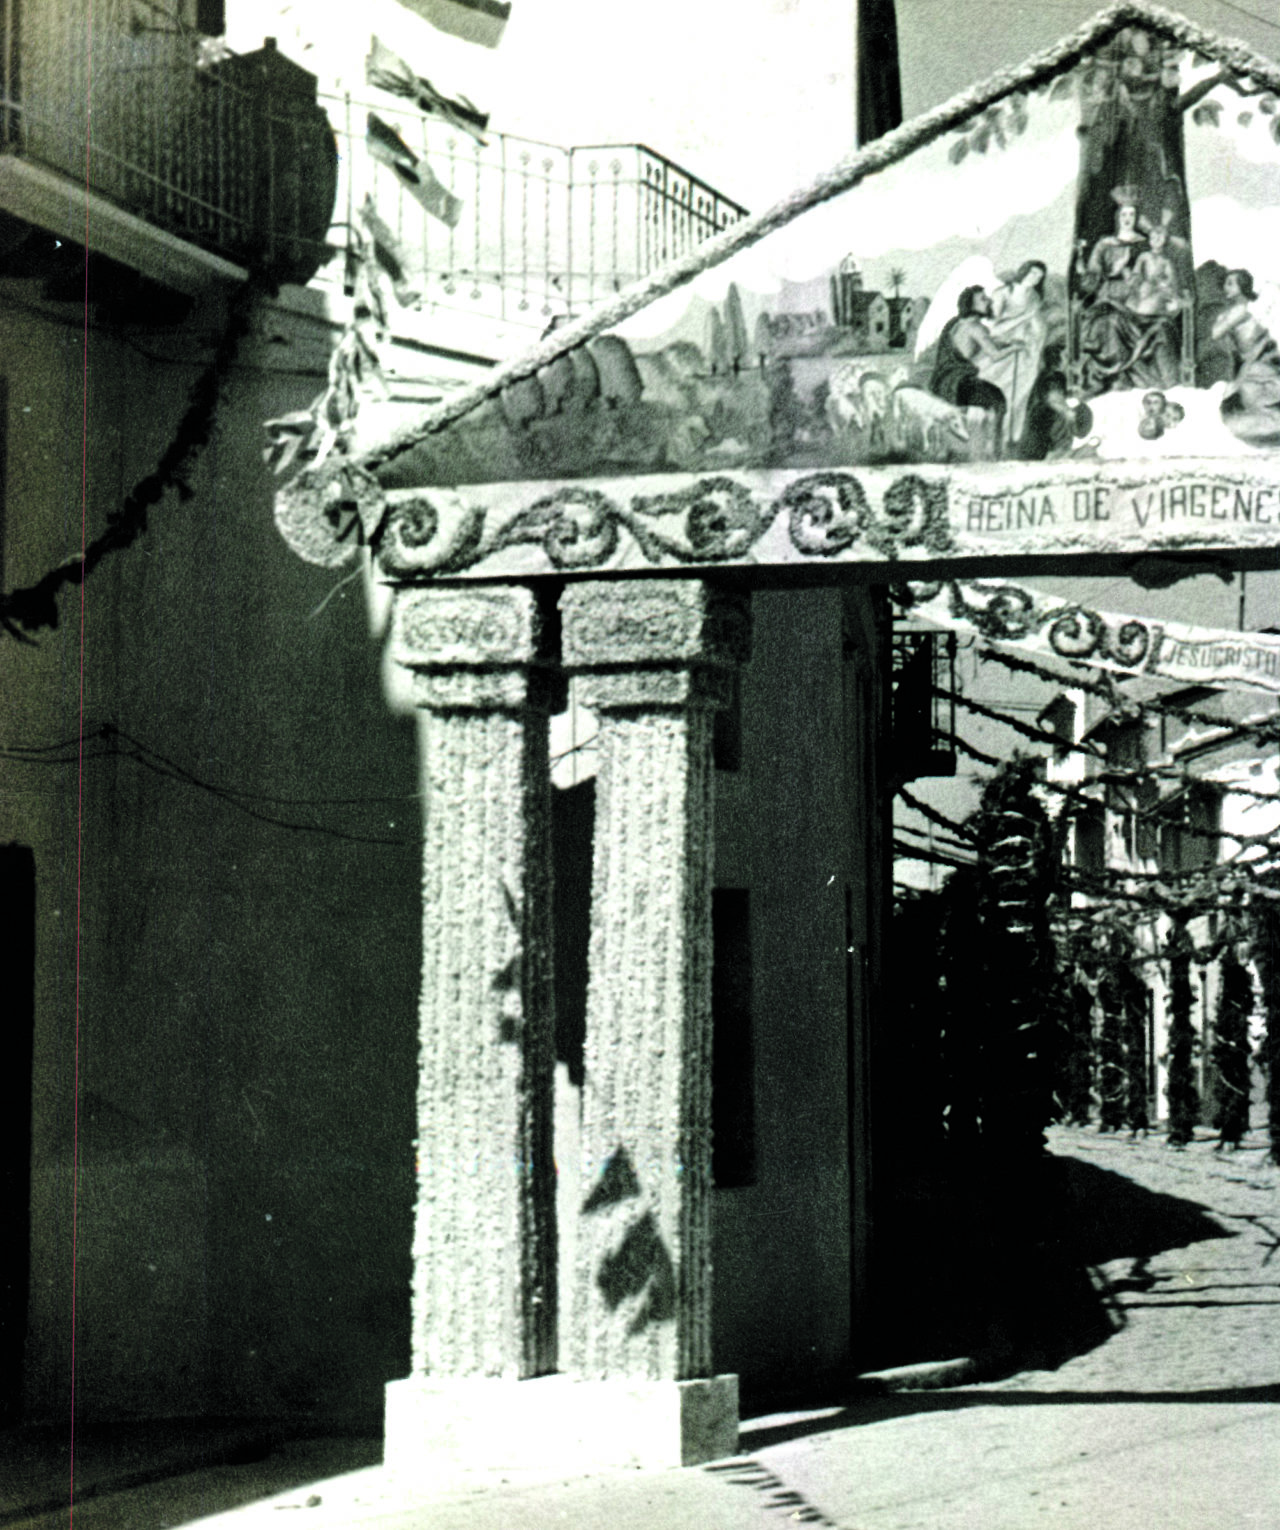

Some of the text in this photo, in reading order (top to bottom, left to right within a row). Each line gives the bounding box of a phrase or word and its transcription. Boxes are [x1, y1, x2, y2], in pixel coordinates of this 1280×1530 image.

[966, 495, 1055, 532] REINA
[1074, 488, 1110, 521] DE
[1163, 644, 1278, 676] JESUCRISTO
